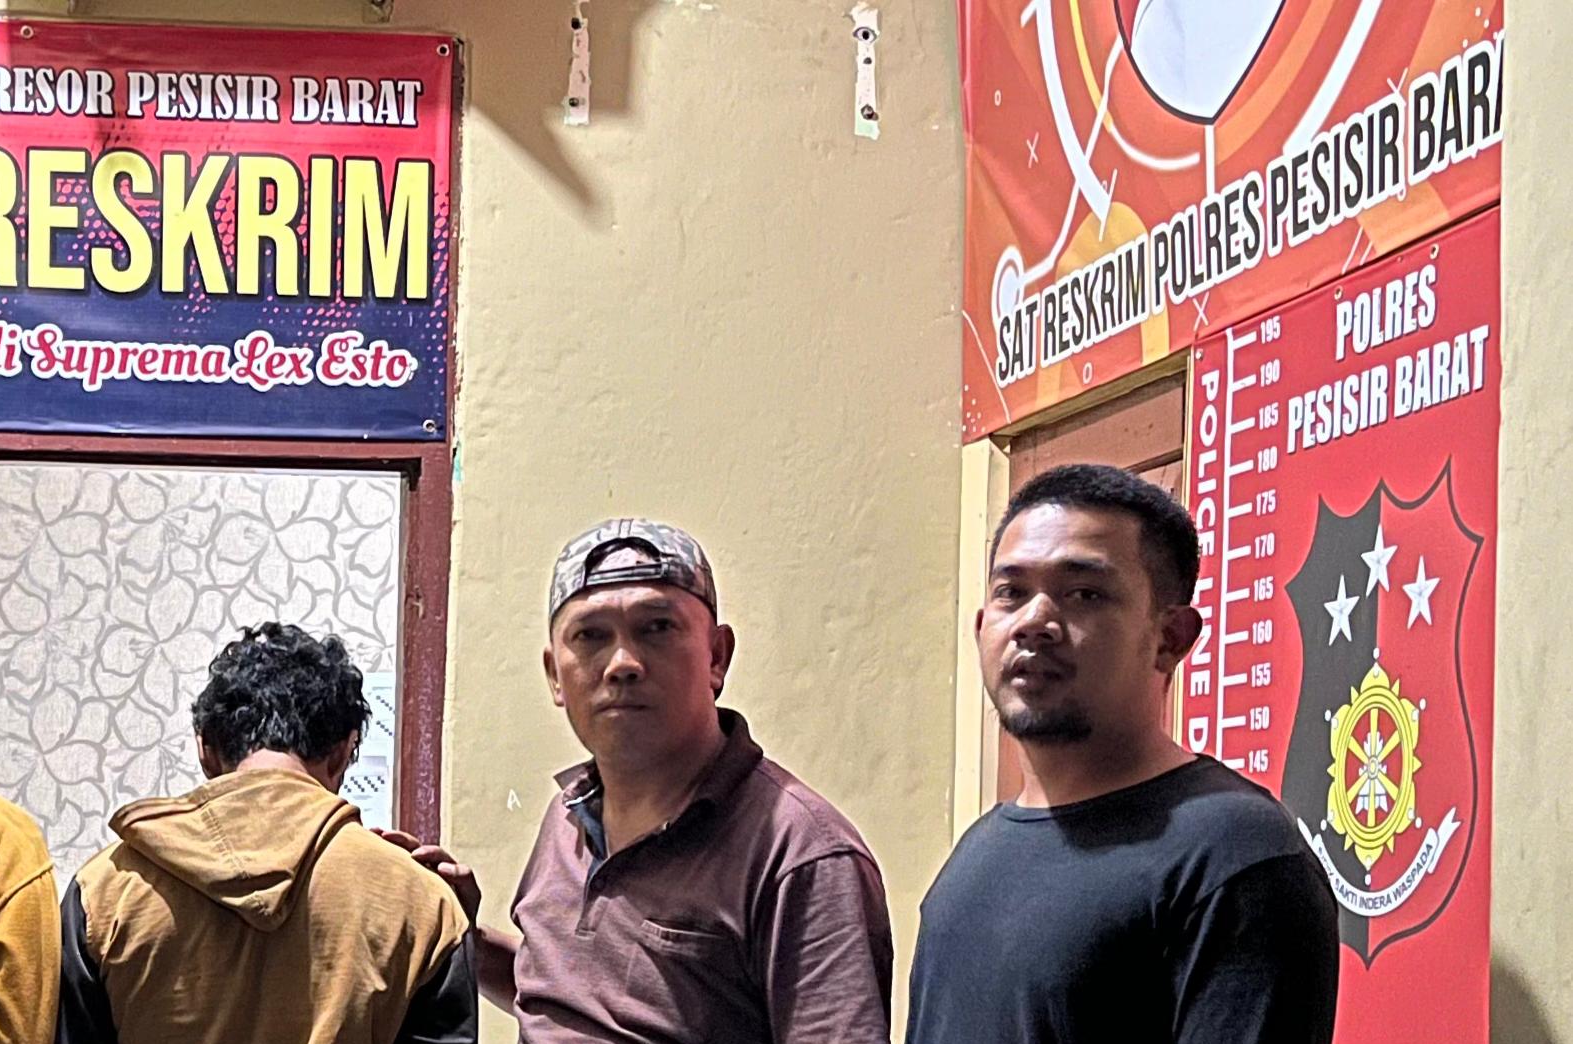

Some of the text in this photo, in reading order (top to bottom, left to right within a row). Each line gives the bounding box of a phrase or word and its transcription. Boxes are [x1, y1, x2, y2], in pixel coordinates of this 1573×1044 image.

[127, 70, 280, 123] PESISIR
[290, 75, 422, 127] BARAT
[997, 299, 1039, 381] SAT
[1042, 240, 1147, 362] RESKRIM
[1153, 179, 1262, 306] POLRES
[1269, 102, 1401, 250] PESISIR
[1334, 263, 1438, 361] POLRES
[1260, 316, 1281, 343] 195
[26, 328, 228, 386] Suprema
[235, 334, 310, 387] Lex
[320, 336, 412, 382] Esto
[1259, 359, 1281, 386] 190
[1285, 323, 1491, 455] PESISIR BARAT
[1258, 402, 1279, 430] 185
[1198, 368, 1220, 557] POLICE
[1256, 446, 1278, 473] 180
[1255, 489, 1277, 516] 175
[1254, 532, 1275, 559] 170
[1253, 576, 1274, 602] 165
[1252, 619, 1273, 645] 160
[1250, 662, 1271, 688] 155
[1249, 705, 1270, 731] 150
[1248, 749, 1269, 775] 145
[1392, 843, 1434, 902] WASPADA
